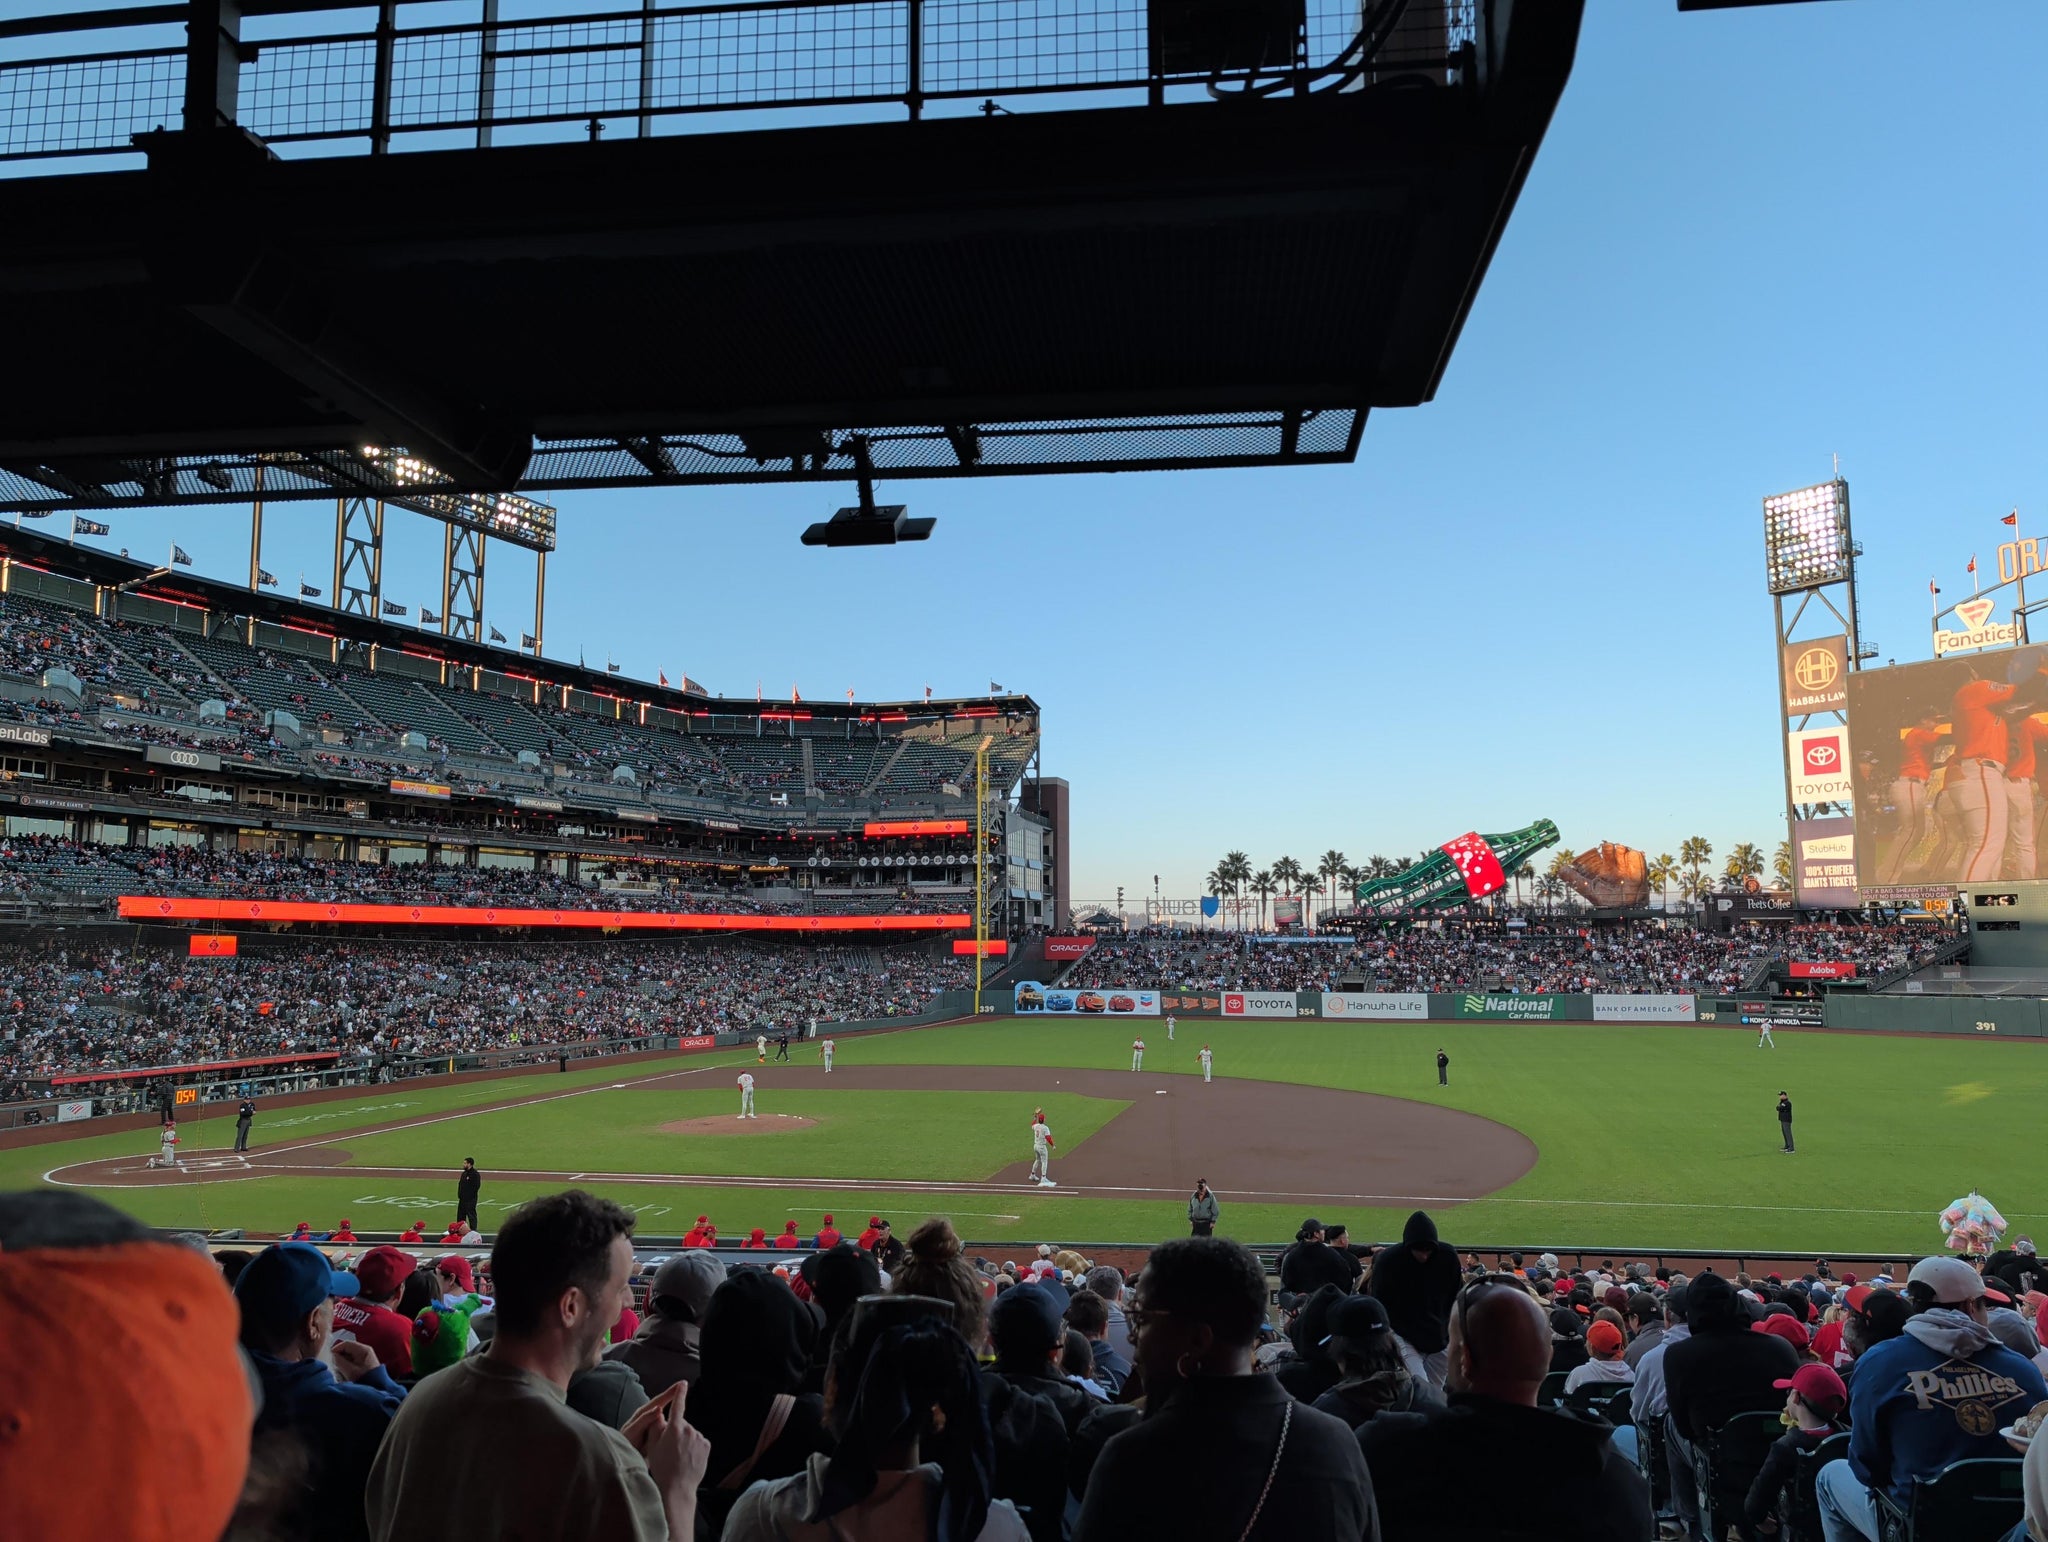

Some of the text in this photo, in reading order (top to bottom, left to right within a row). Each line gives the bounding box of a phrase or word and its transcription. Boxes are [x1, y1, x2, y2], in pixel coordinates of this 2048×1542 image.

[1938, 626, 2016, 650] Fanatics
[1789, 691, 1846, 707] HABBAS LAW
[0, 727, 48, 744] enLabs
[1796, 781, 1852, 796] TOYOTA
[1808, 844, 1847, 854] StubHub
[1805, 864, 1854, 877] 100% VERIFIED
[1804, 876, 1857, 888] GIANTS TICKETS
[1767, 898, 1791, 910] Coffee
[1925, 900, 1947, 911] 0:54
[1050, 944, 1090, 952] ORACLE
[1809, 966, 1836, 974] Adobe
[1247, 999, 1293, 1009] TOYOTA
[1347, 1000, 1422, 1011] Hanwha Life
[1485, 997, 1554, 1012] National
[1298, 1007, 1316, 1016] 354
[1508, 1012, 1551, 1020] Car Rental
[1700, 1012, 1716, 1021] 399
[1773, 1018, 1800, 1026] MINOLTA
[1976, 1021, 1996, 1031] 391
[684, 1038, 710, 1047] ORACLE
[1907, 1370, 2018, 1410] Phillies
